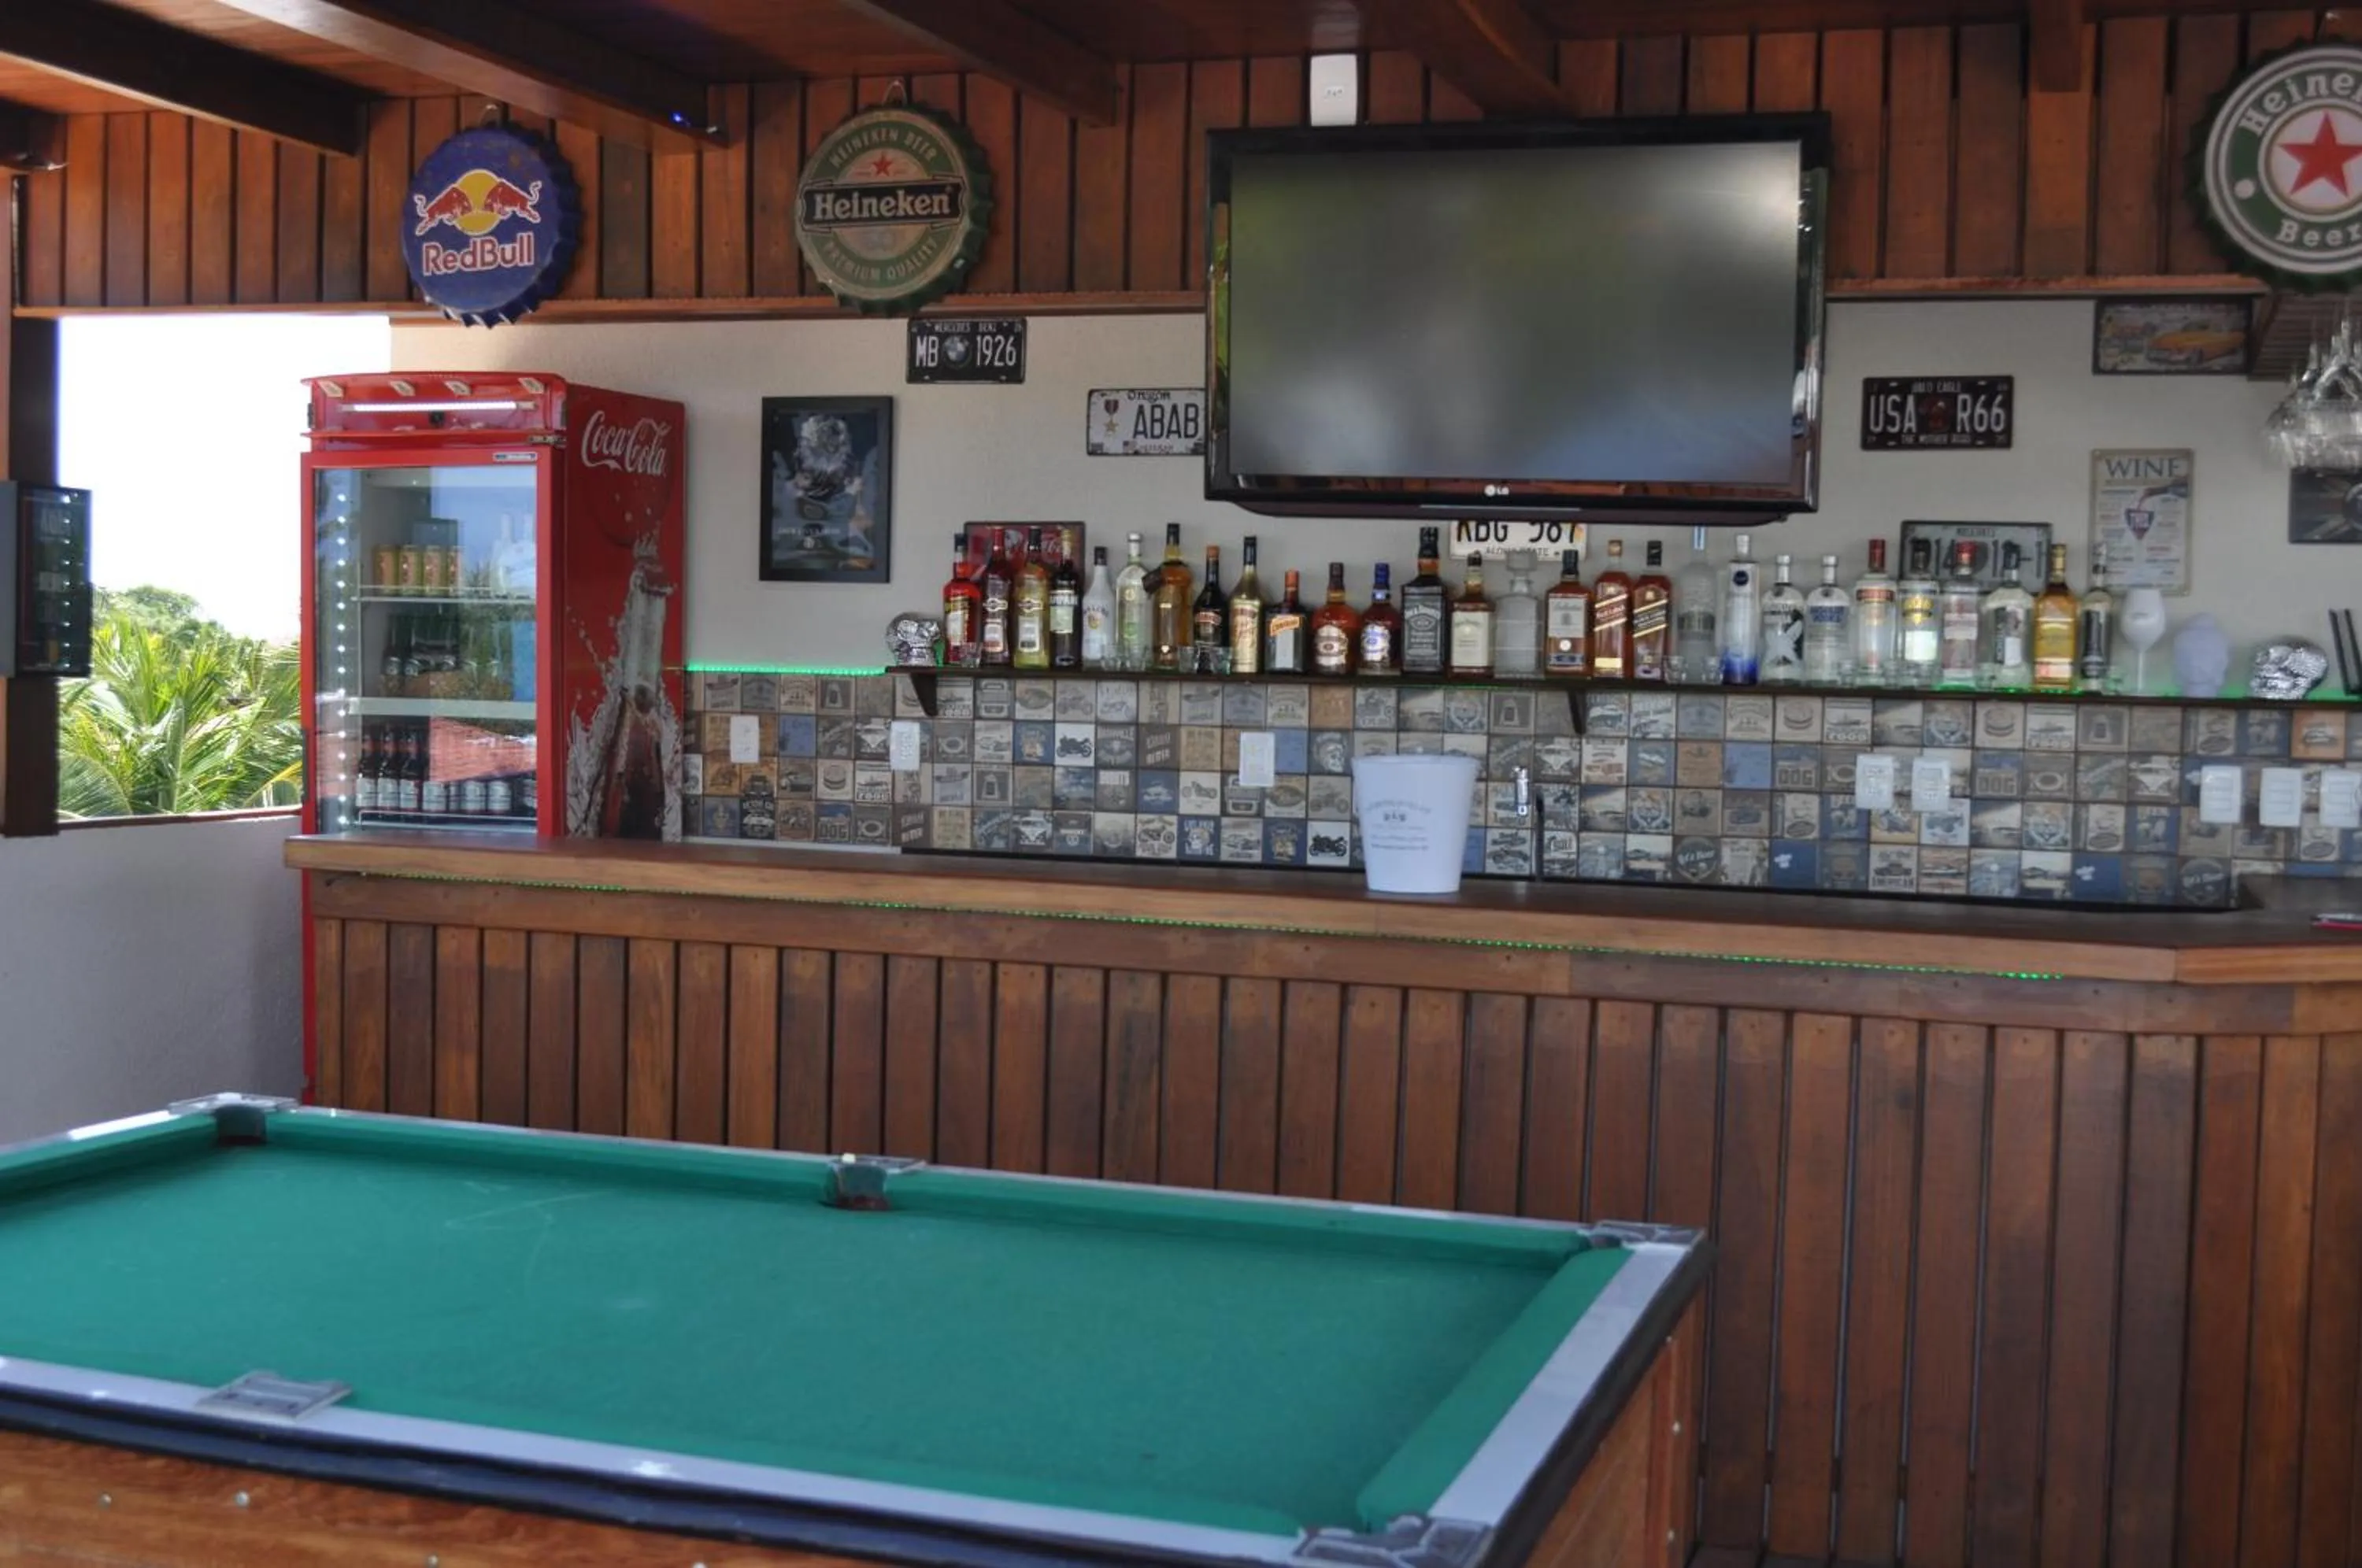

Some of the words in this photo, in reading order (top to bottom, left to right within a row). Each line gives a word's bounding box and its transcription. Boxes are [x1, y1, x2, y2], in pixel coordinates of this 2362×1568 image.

[2239, 72, 2362, 137] Heine
[829, 127, 899, 168] HEINEKEN
[903, 131, 939, 161] BEER
[813, 188, 950, 221] Heineken
[2276, 218, 2362, 246] Beer
[824, 240, 881, 280] PREMIUM
[887, 236, 939, 280] QUALITY
[916, 335, 940, 368] MB
[976, 334, 1017, 368] 1926
[1132, 403, 1199, 439] ABAB
[1869, 394, 1917, 433] USA
[1957, 394, 2006, 433] R66
[581, 410, 672, 477] Coca-Cola
